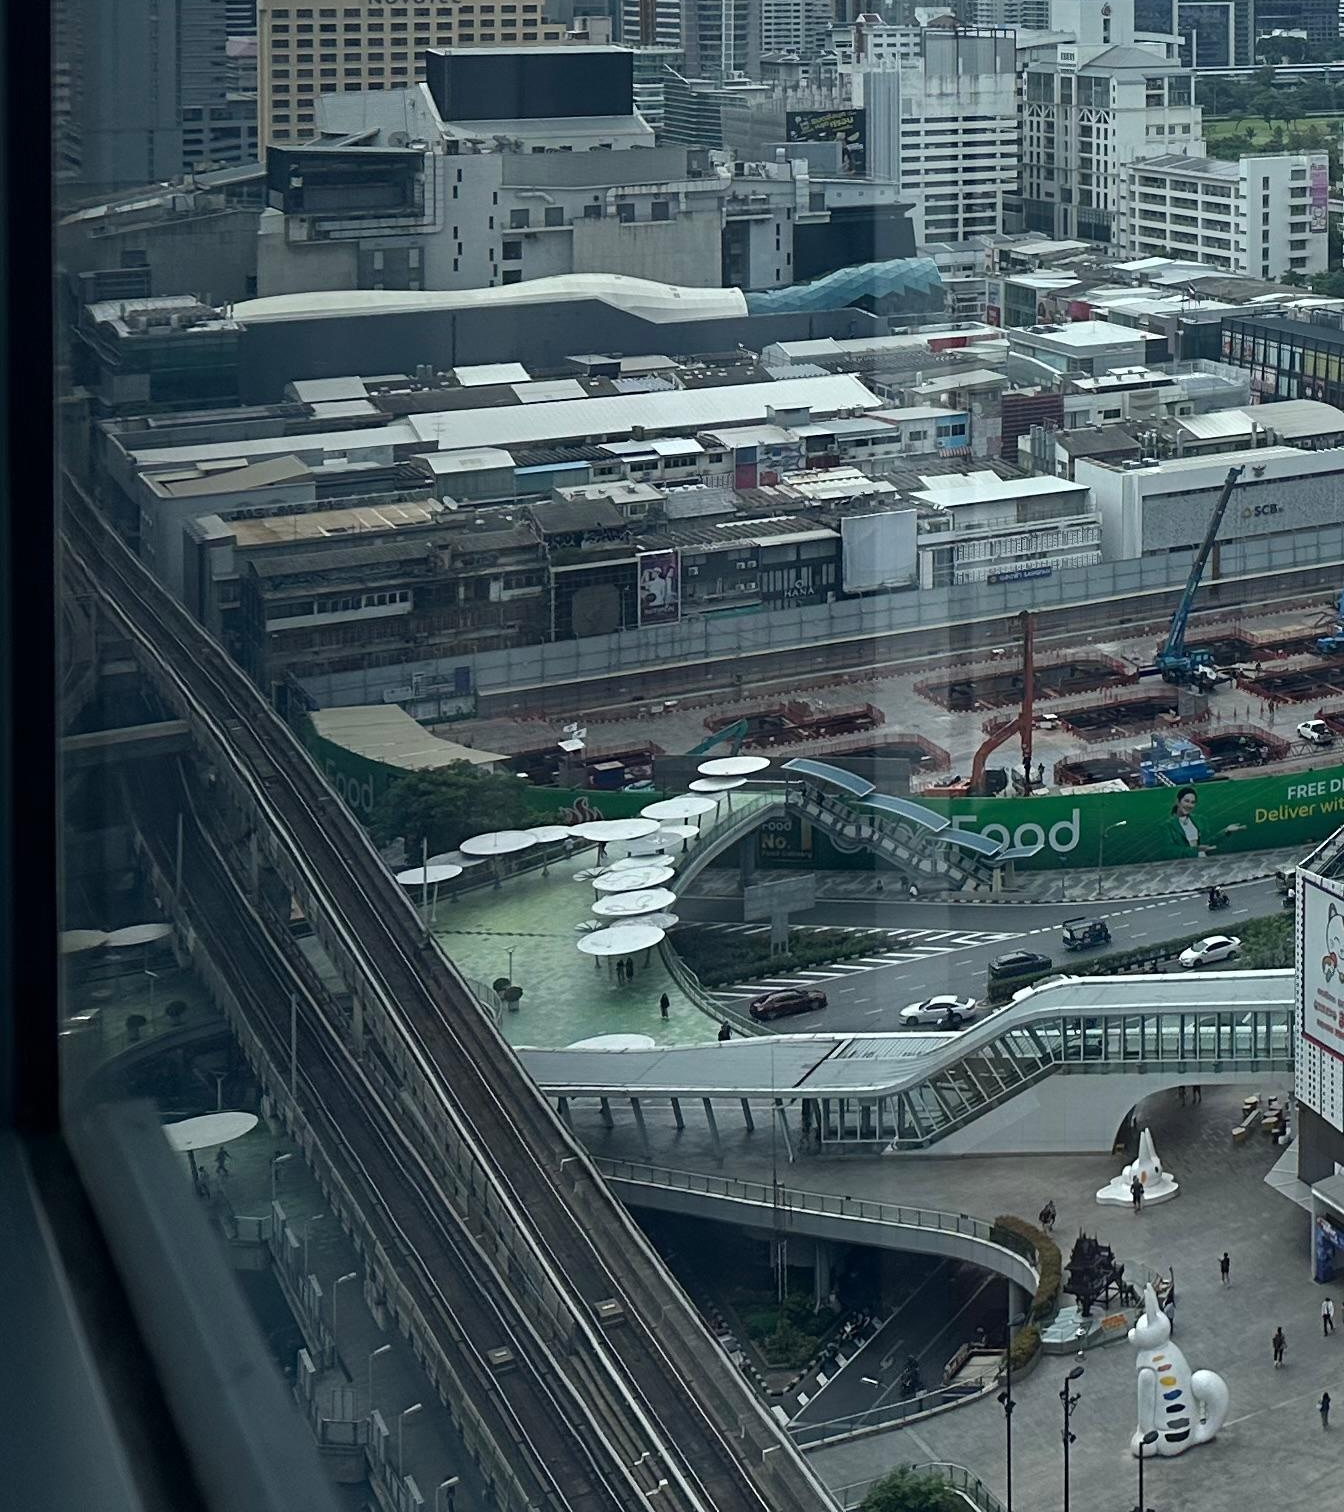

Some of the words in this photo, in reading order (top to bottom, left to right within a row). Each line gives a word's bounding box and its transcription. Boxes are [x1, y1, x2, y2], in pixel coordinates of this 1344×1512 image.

[1254, 503, 1278, 518] SCB
[1287, 781, 1327, 801] FREE
[1255, 804, 1316, 824] Deliver
